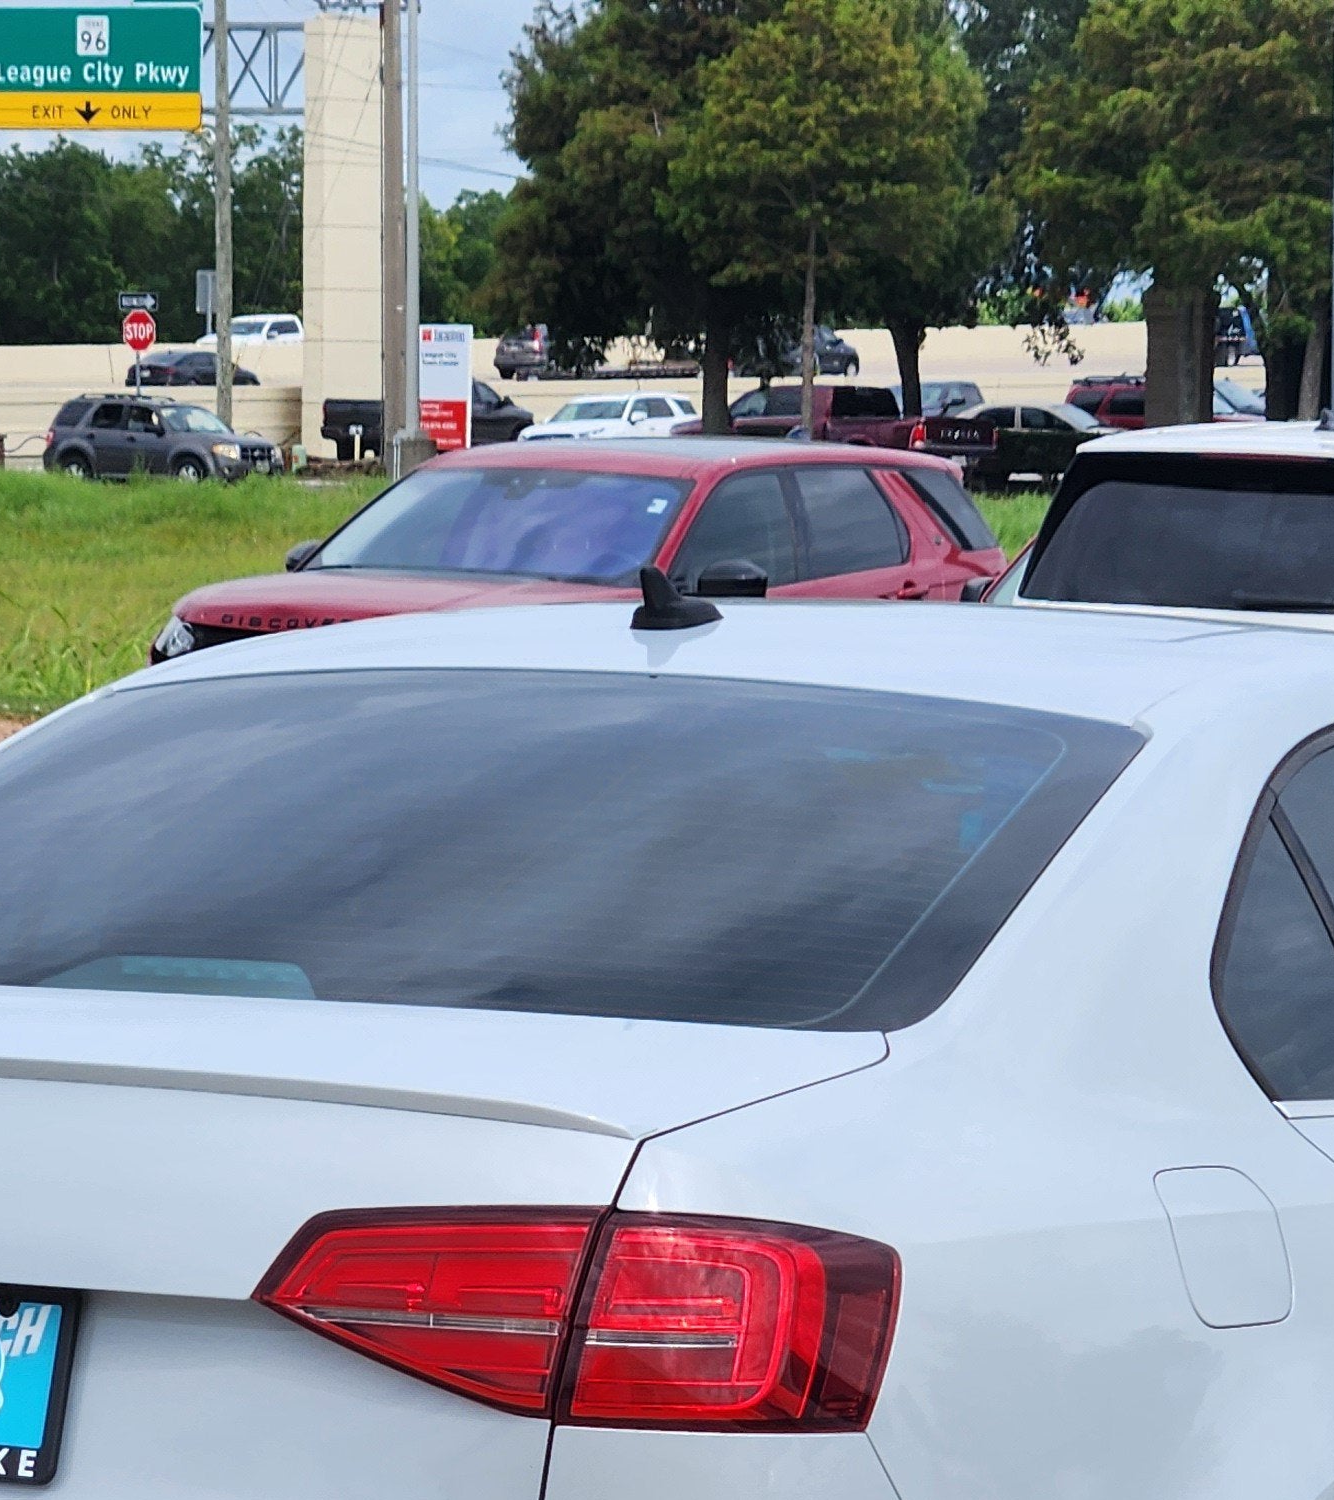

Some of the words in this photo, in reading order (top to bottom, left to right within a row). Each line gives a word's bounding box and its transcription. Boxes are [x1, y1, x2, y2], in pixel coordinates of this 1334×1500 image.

[81, 31, 106, 51] 96
[83, 60, 123, 88] City
[135, 61, 189, 88] Pkwy
[32, 105, 64, 119] EXIT
[111, 105, 152, 119] ONLY
[125, 323, 153, 340] STOP
